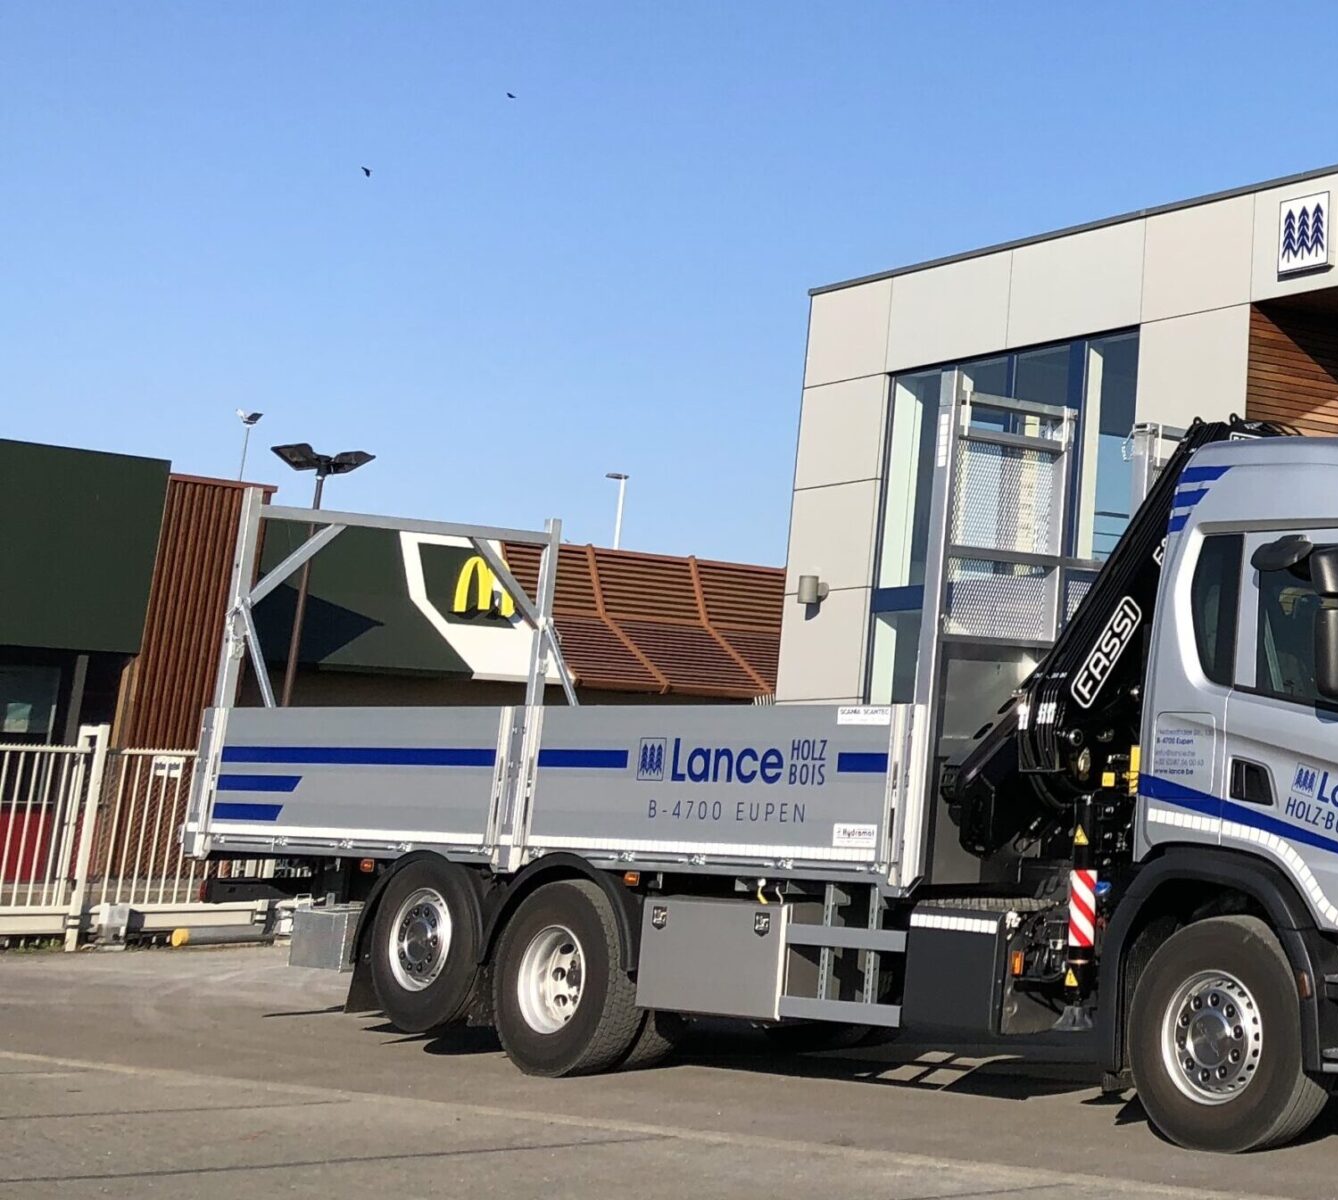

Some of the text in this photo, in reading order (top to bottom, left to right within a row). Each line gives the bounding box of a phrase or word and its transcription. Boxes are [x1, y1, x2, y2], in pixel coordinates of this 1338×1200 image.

[1076, 604, 1137, 700] FASSI
[671, 737, 784, 784] Lance
[790, 739, 828, 762] HOLZ
[788, 763, 826, 786] BOIS
[648, 799, 806, 823] B-4700 EUPEN
